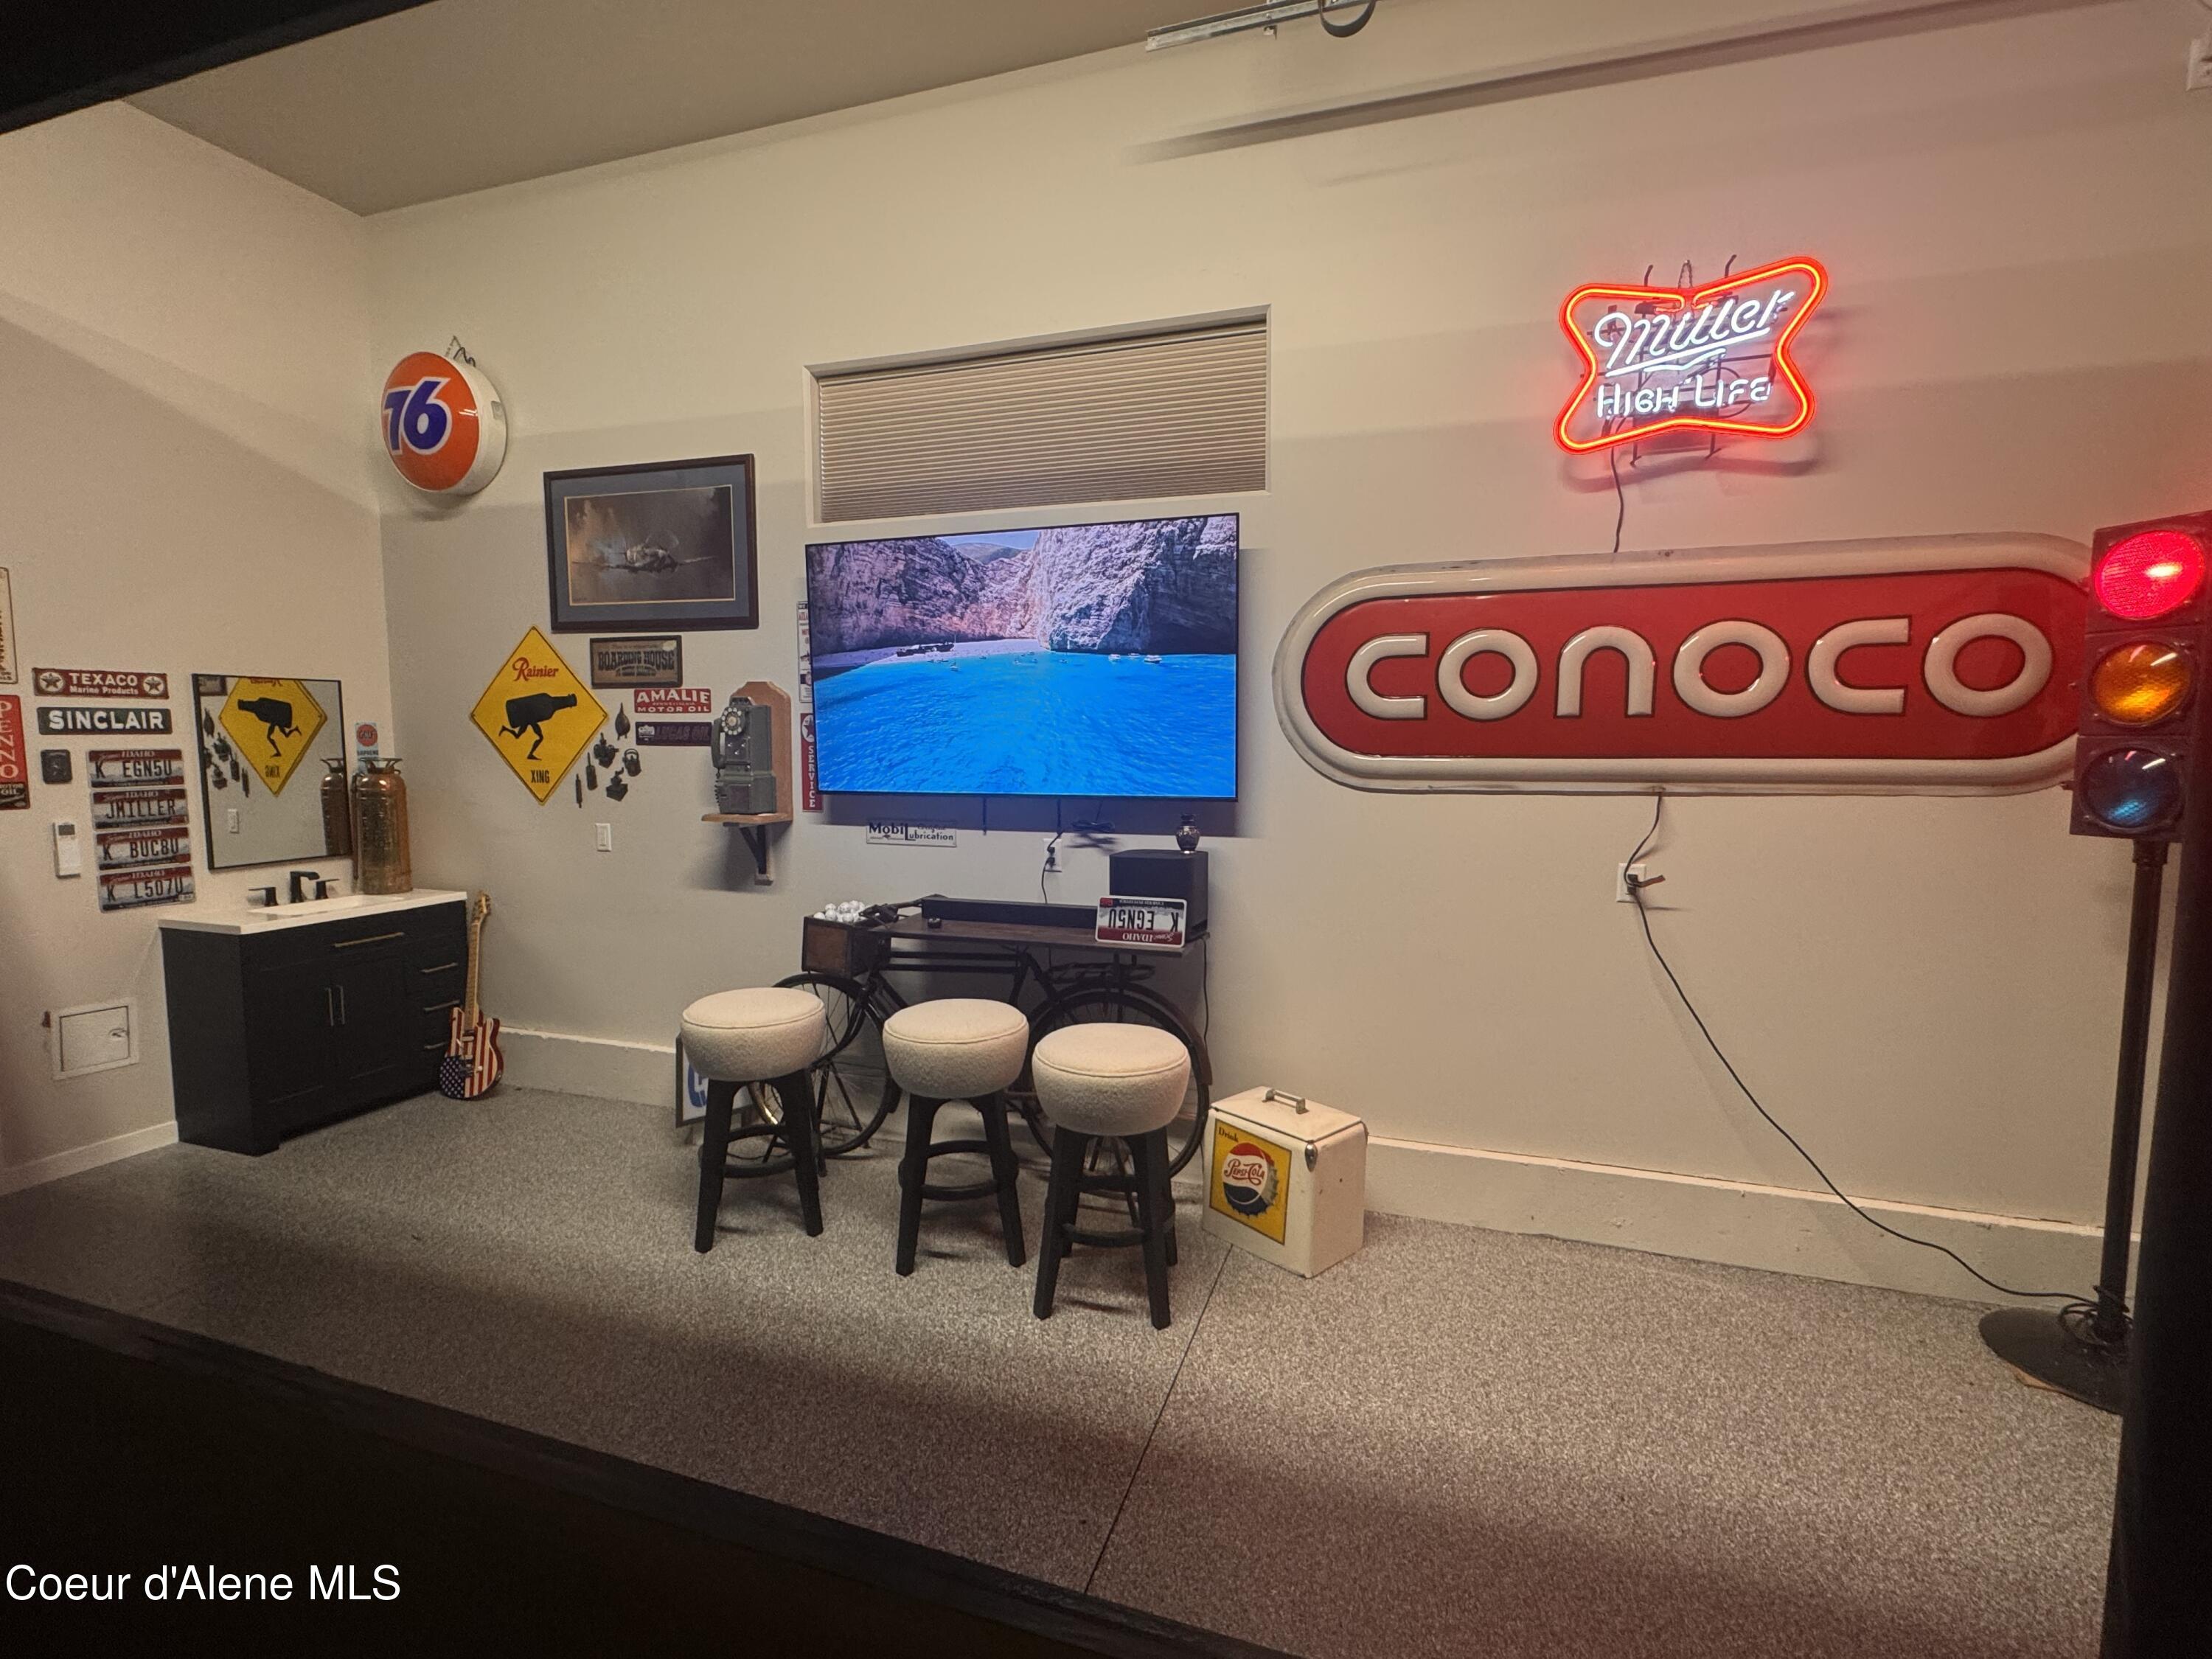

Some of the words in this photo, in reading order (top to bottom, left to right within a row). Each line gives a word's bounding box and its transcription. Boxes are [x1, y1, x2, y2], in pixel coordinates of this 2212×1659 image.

[1593, 290, 1795, 369] Miller
[1596, 383, 1680, 419] HIGH
[1694, 375, 1772, 407] LIFE
[383, 377, 452, 455] 76
[512, 656, 559, 681] Rainier
[644, 650, 675, 670] HOUSE
[69, 672, 138, 686] TEXACO
[69, 686, 100, 694] Marine
[102, 686, 139, 695] Products
[636, 689, 710, 703] AMALIE
[49, 710, 164, 729] SINCLAIR
[94, 759, 105, 779] K
[122, 759, 173, 778] EGN5U
[530, 770, 550, 785] XING
[102, 843, 113, 861] K
[129, 838, 179, 859] BUC8U
[106, 884, 116, 902] K
[1108, 908, 1155, 931] EGN5U
[1169, 912, 1179, 932] K
[1122, 932, 1154, 942] IDAHO
[1218, 1127, 1239, 1142] Drink
